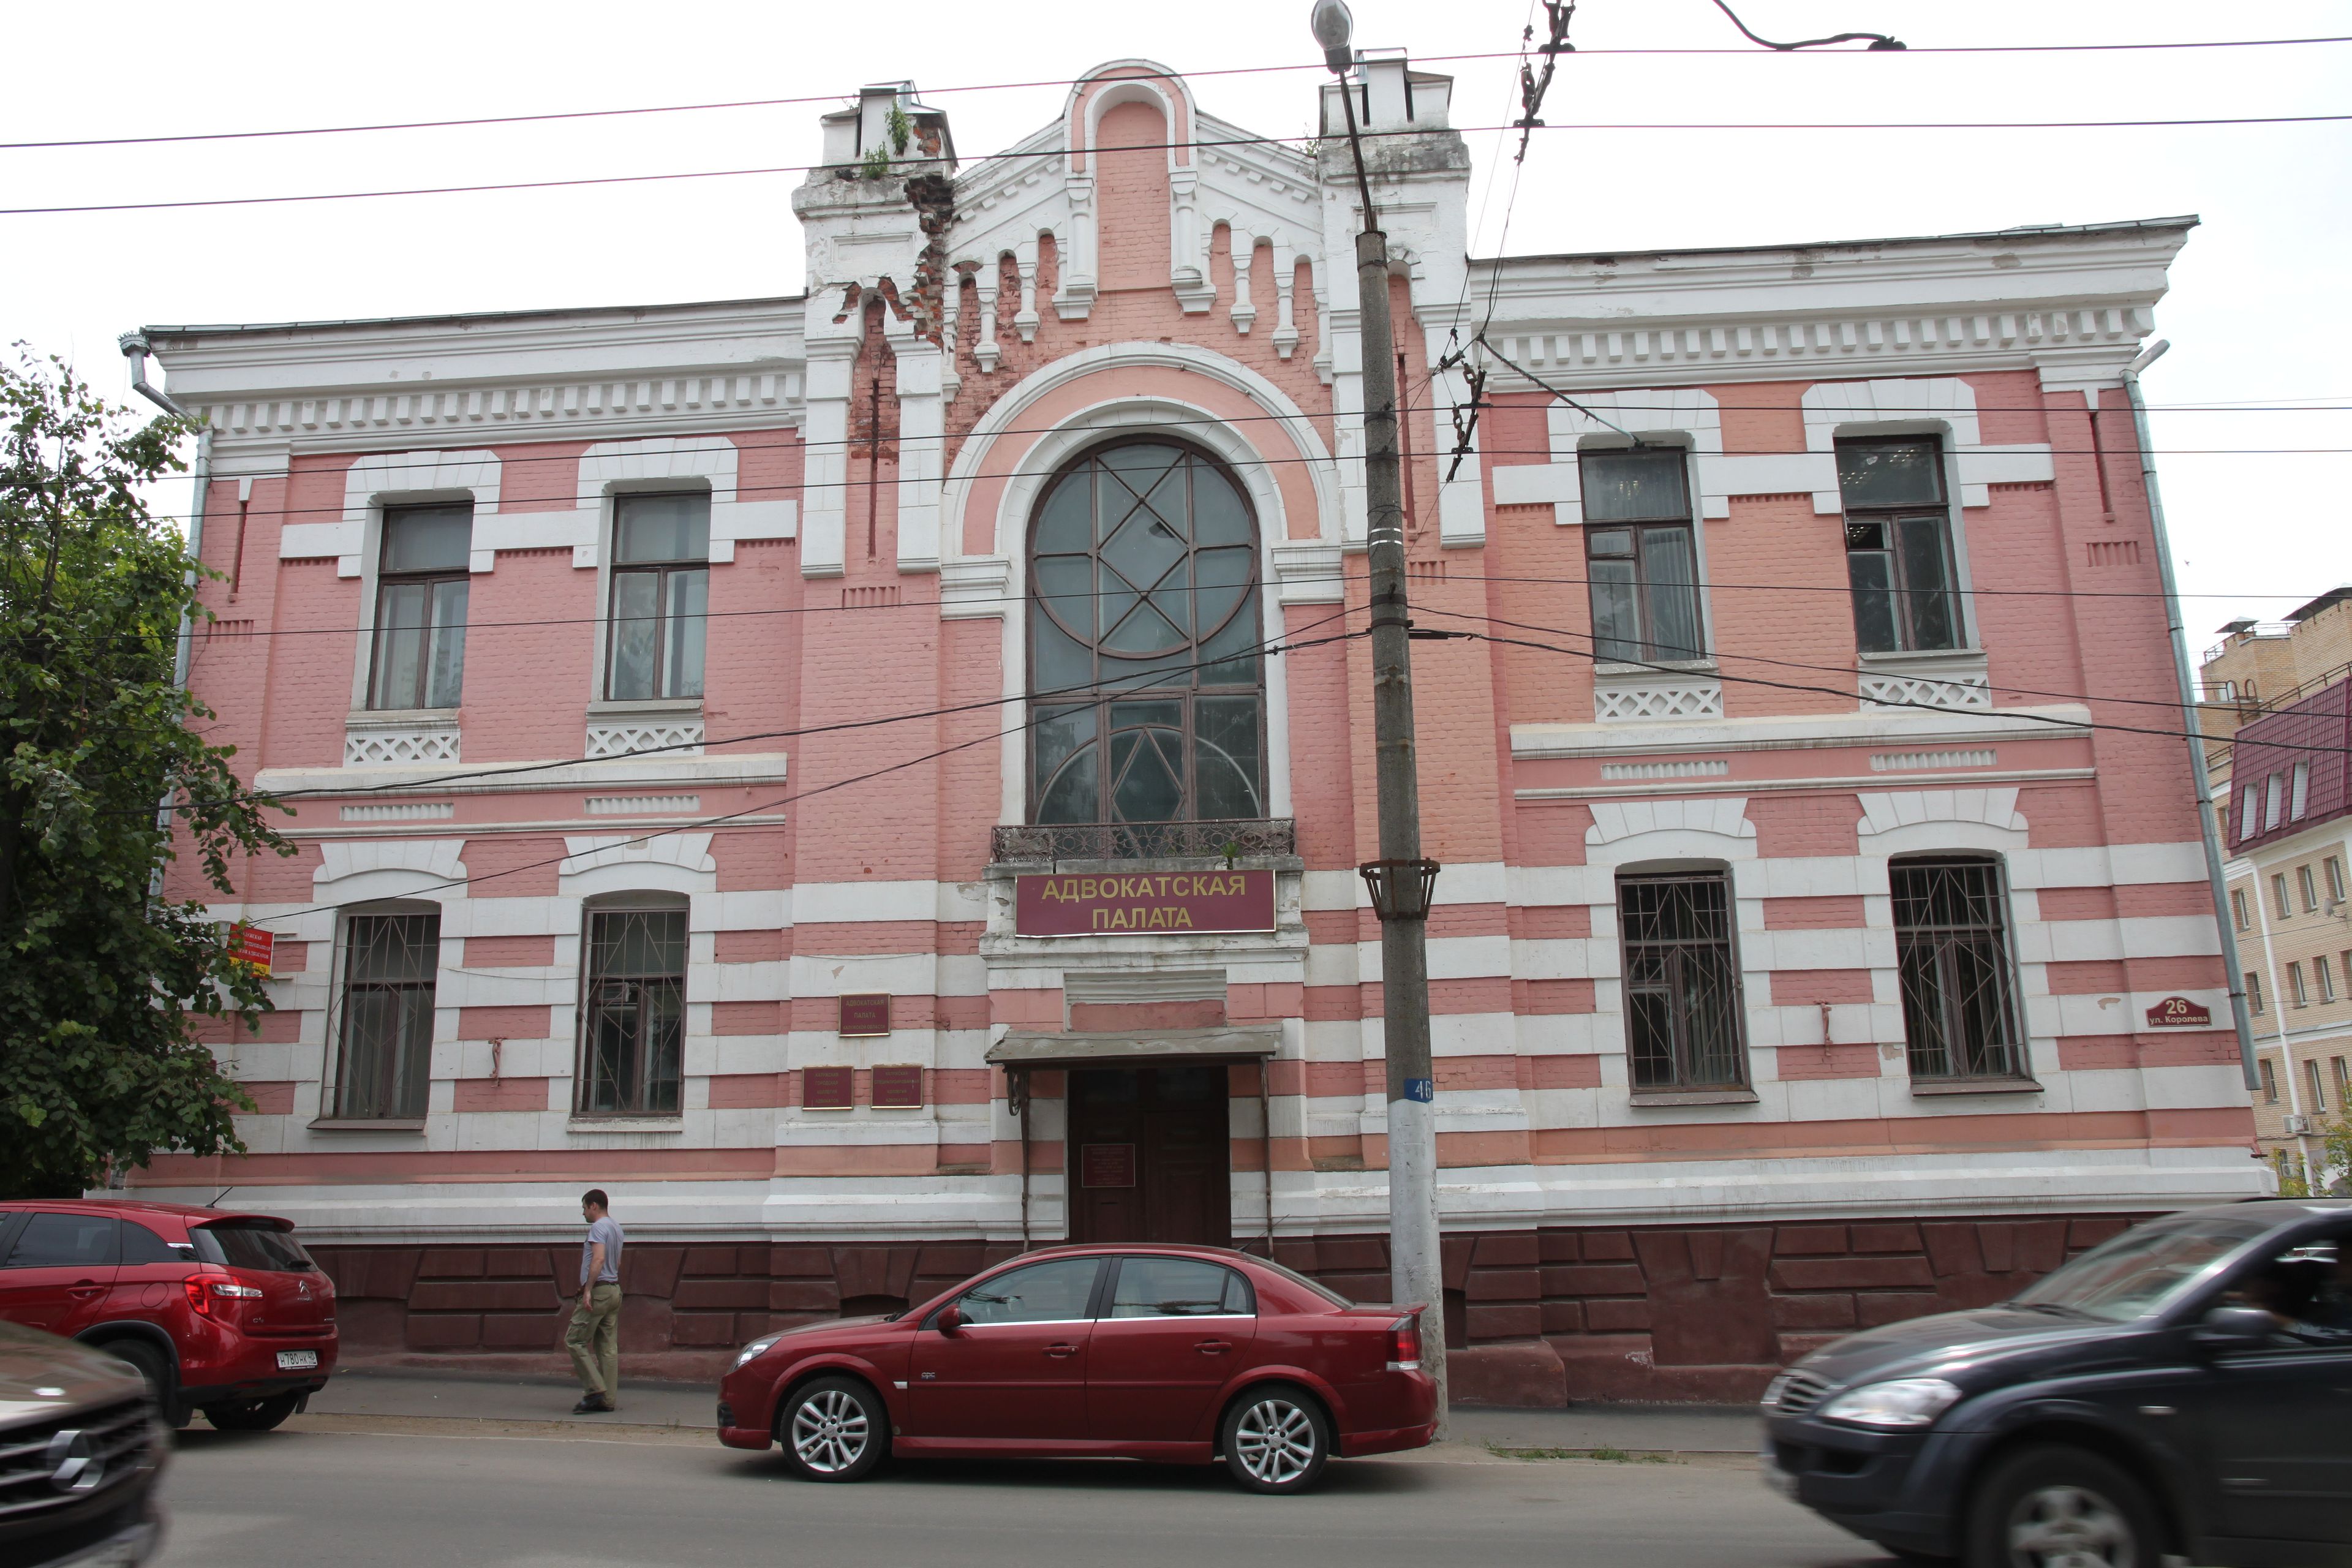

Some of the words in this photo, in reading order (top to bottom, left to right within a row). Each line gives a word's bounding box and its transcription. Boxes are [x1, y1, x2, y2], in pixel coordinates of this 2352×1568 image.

[1041, 875, 1246, 903] АДВОКАТСКАЯ
[1093, 907, 1193, 929] ПАЛАТА
[2165, 1000, 2187, 1014] 26
[2165, 1016, 2208, 1025] Королева
[1415, 1080, 1431, 1099] 46
